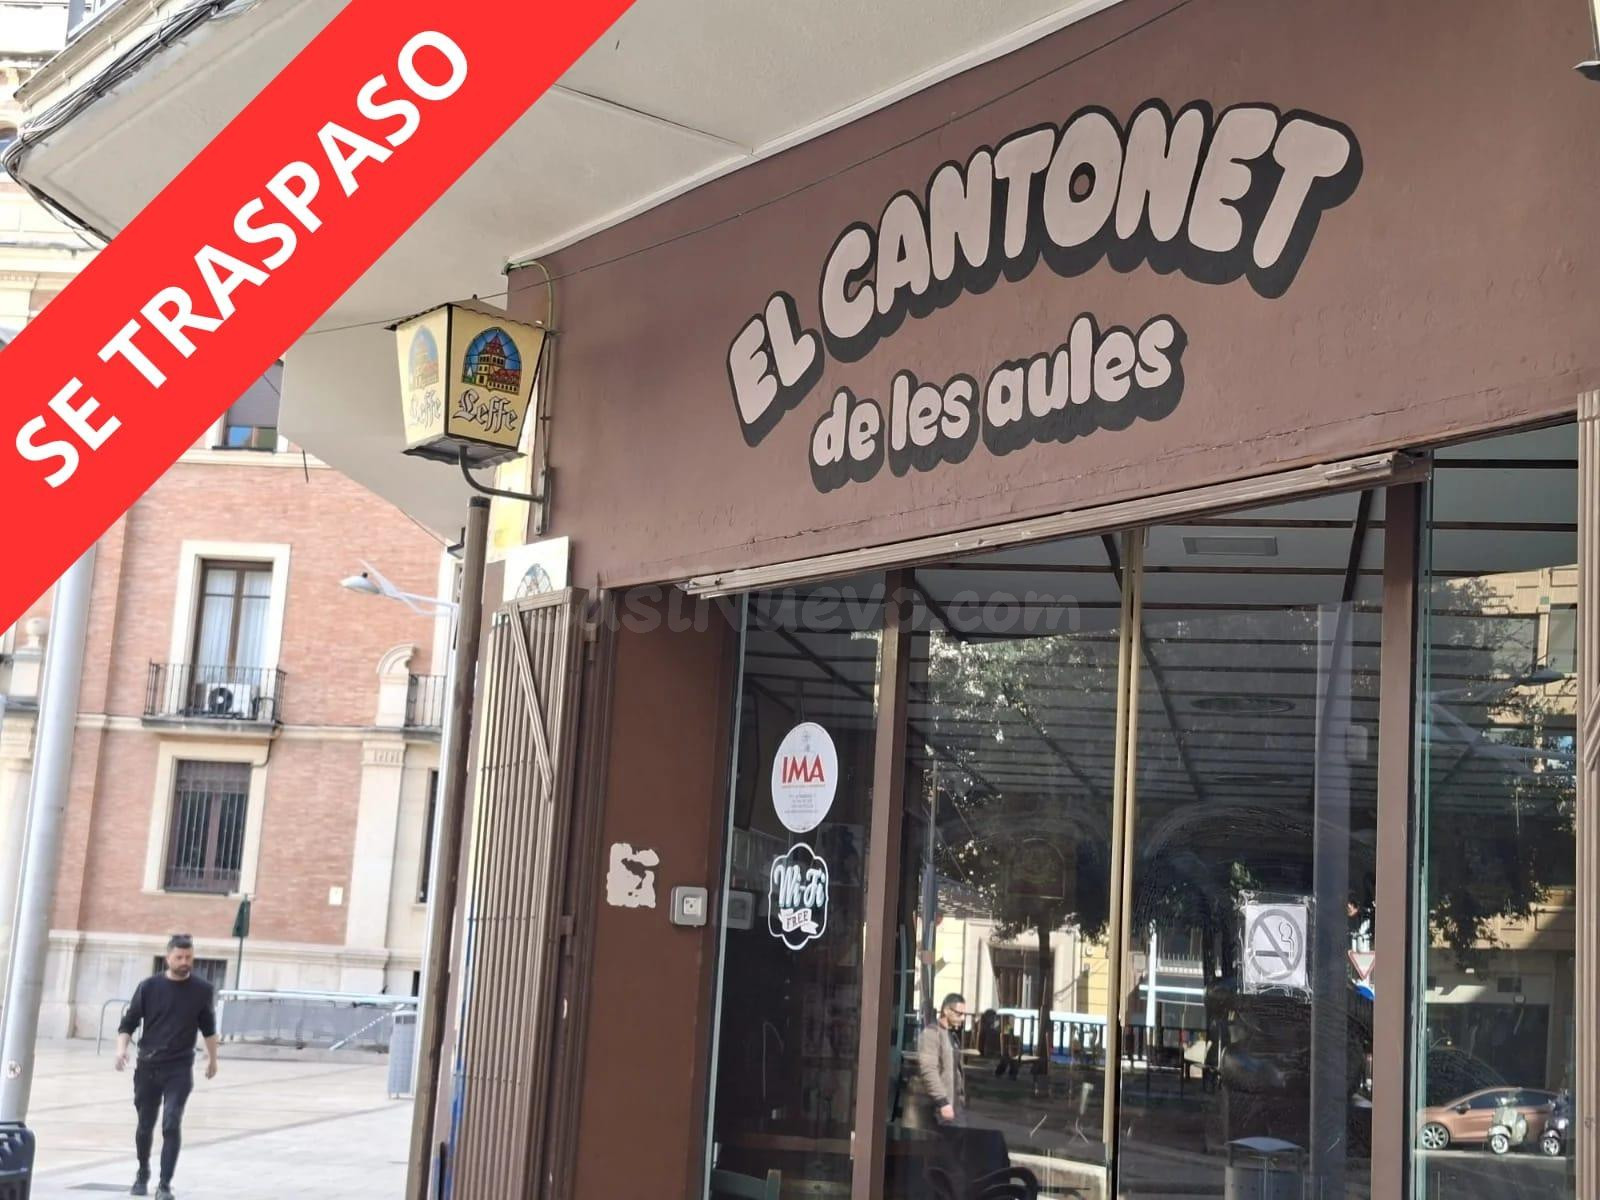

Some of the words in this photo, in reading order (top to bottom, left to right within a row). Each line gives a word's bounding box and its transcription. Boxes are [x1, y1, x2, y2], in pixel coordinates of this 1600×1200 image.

[728, 294, 819, 429] EL
[821, 104, 1353, 343] CANTONET
[452, 388, 518, 433] Leffe
[811, 391, 882, 468] de
[890, 374, 973, 453] les
[985, 316, 1176, 429] aules
[782, 754, 825, 784] IMA
[774, 865, 826, 908] Wi-Fi
[786, 910, 809, 929] FREE
